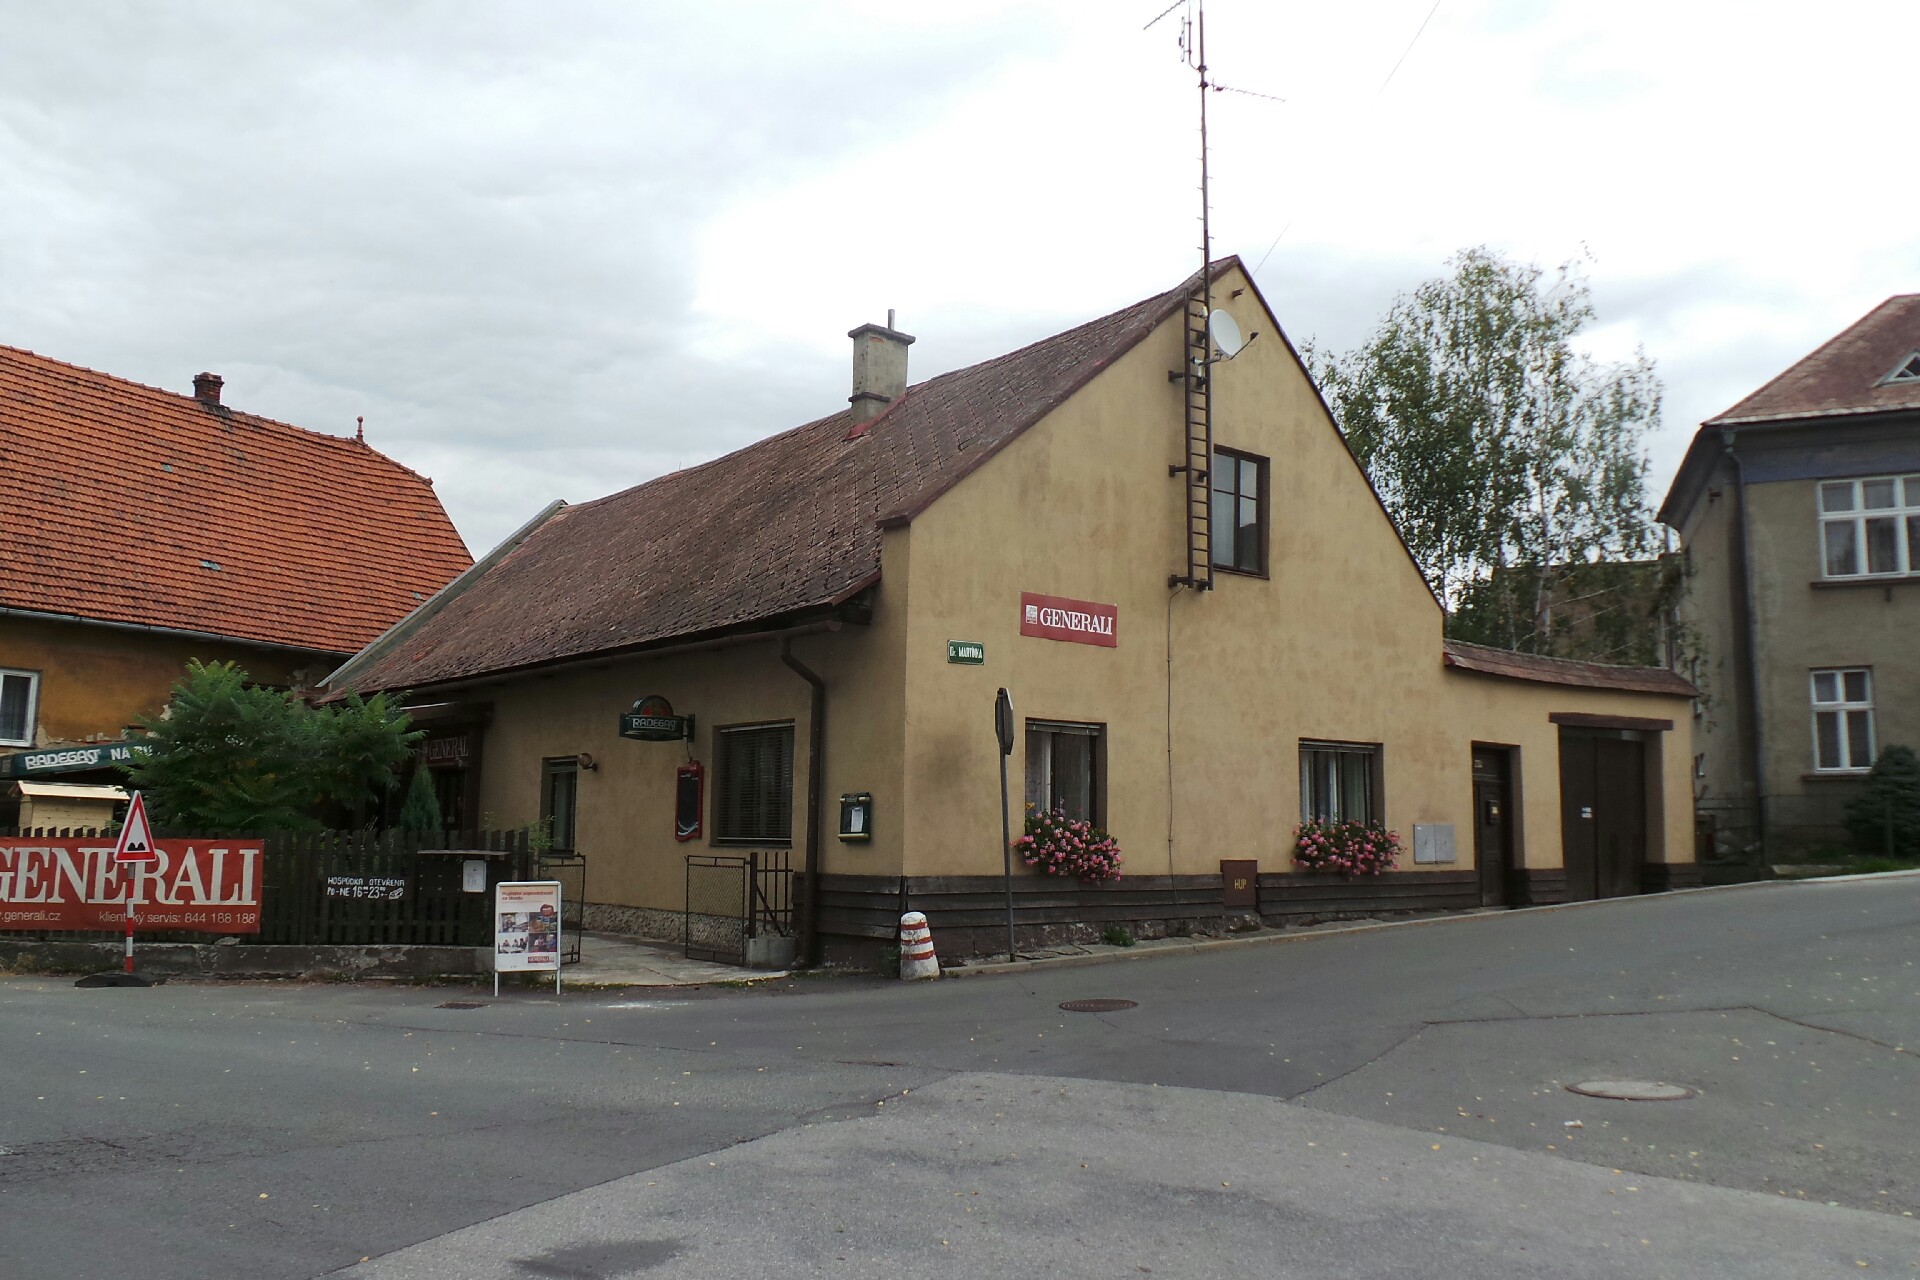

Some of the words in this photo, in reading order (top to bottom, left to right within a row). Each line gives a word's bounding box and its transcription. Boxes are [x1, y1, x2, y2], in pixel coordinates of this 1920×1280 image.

[1039, 607, 1113, 635] GENERALI
[632, 718, 677, 731] RADEGAST
[25, 749, 100, 770] RADEGAST
[147, 912, 181, 923] servis:
[185, 912, 206, 923] 844
[211, 913, 231, 924] 188
[236, 913, 255, 924] 188
